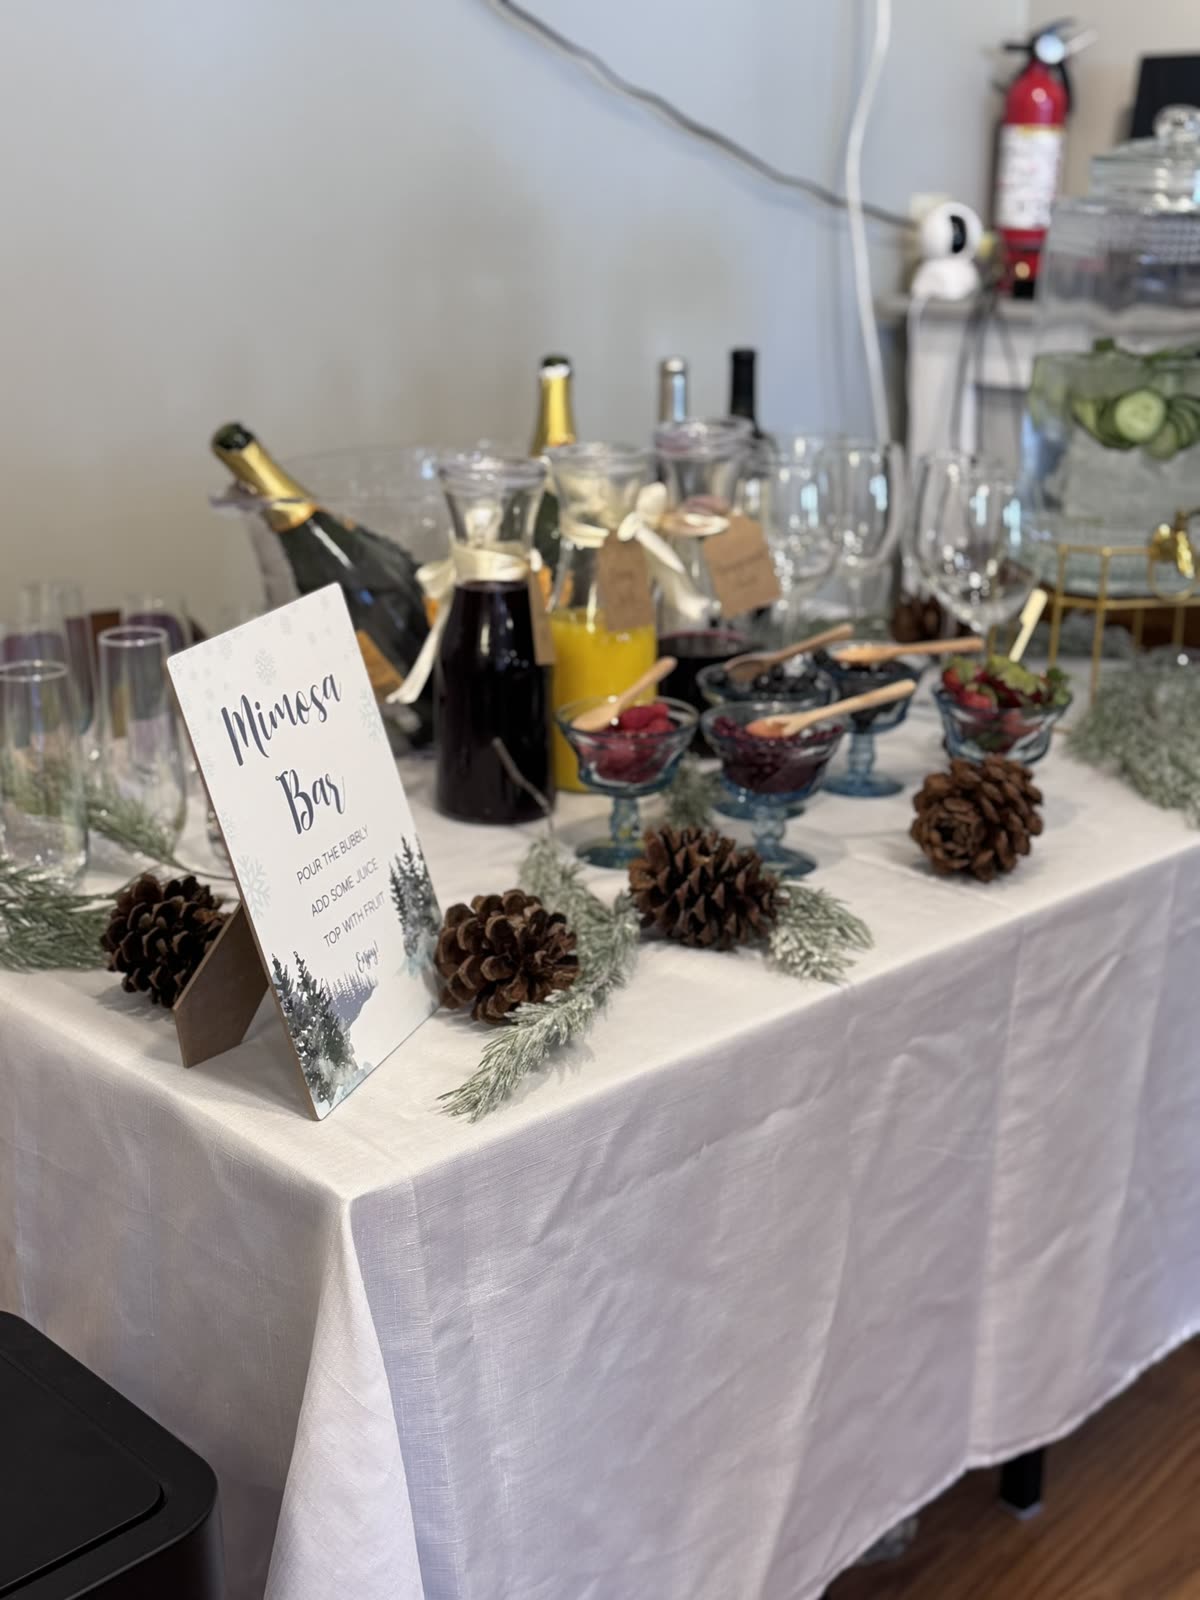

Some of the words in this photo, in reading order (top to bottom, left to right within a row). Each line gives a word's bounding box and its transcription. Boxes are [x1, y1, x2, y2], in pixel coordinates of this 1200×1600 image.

[221, 674, 342, 766] Mimosa
[275, 769, 345, 834] Bar
[296, 858, 323, 885] POUR
[321, 845, 340, 866] THE
[338, 824, 369, 855] BUBBLY
[311, 894, 330, 917] ADD
[330, 875, 354, 902] SOME
[355, 857, 379, 884] JUICE
[323, 926, 341, 948] TOP
[342, 908, 365, 933] WITH
[363, 891, 386, 918] FRUIT
[355, 940, 379, 974] Enjoy!
